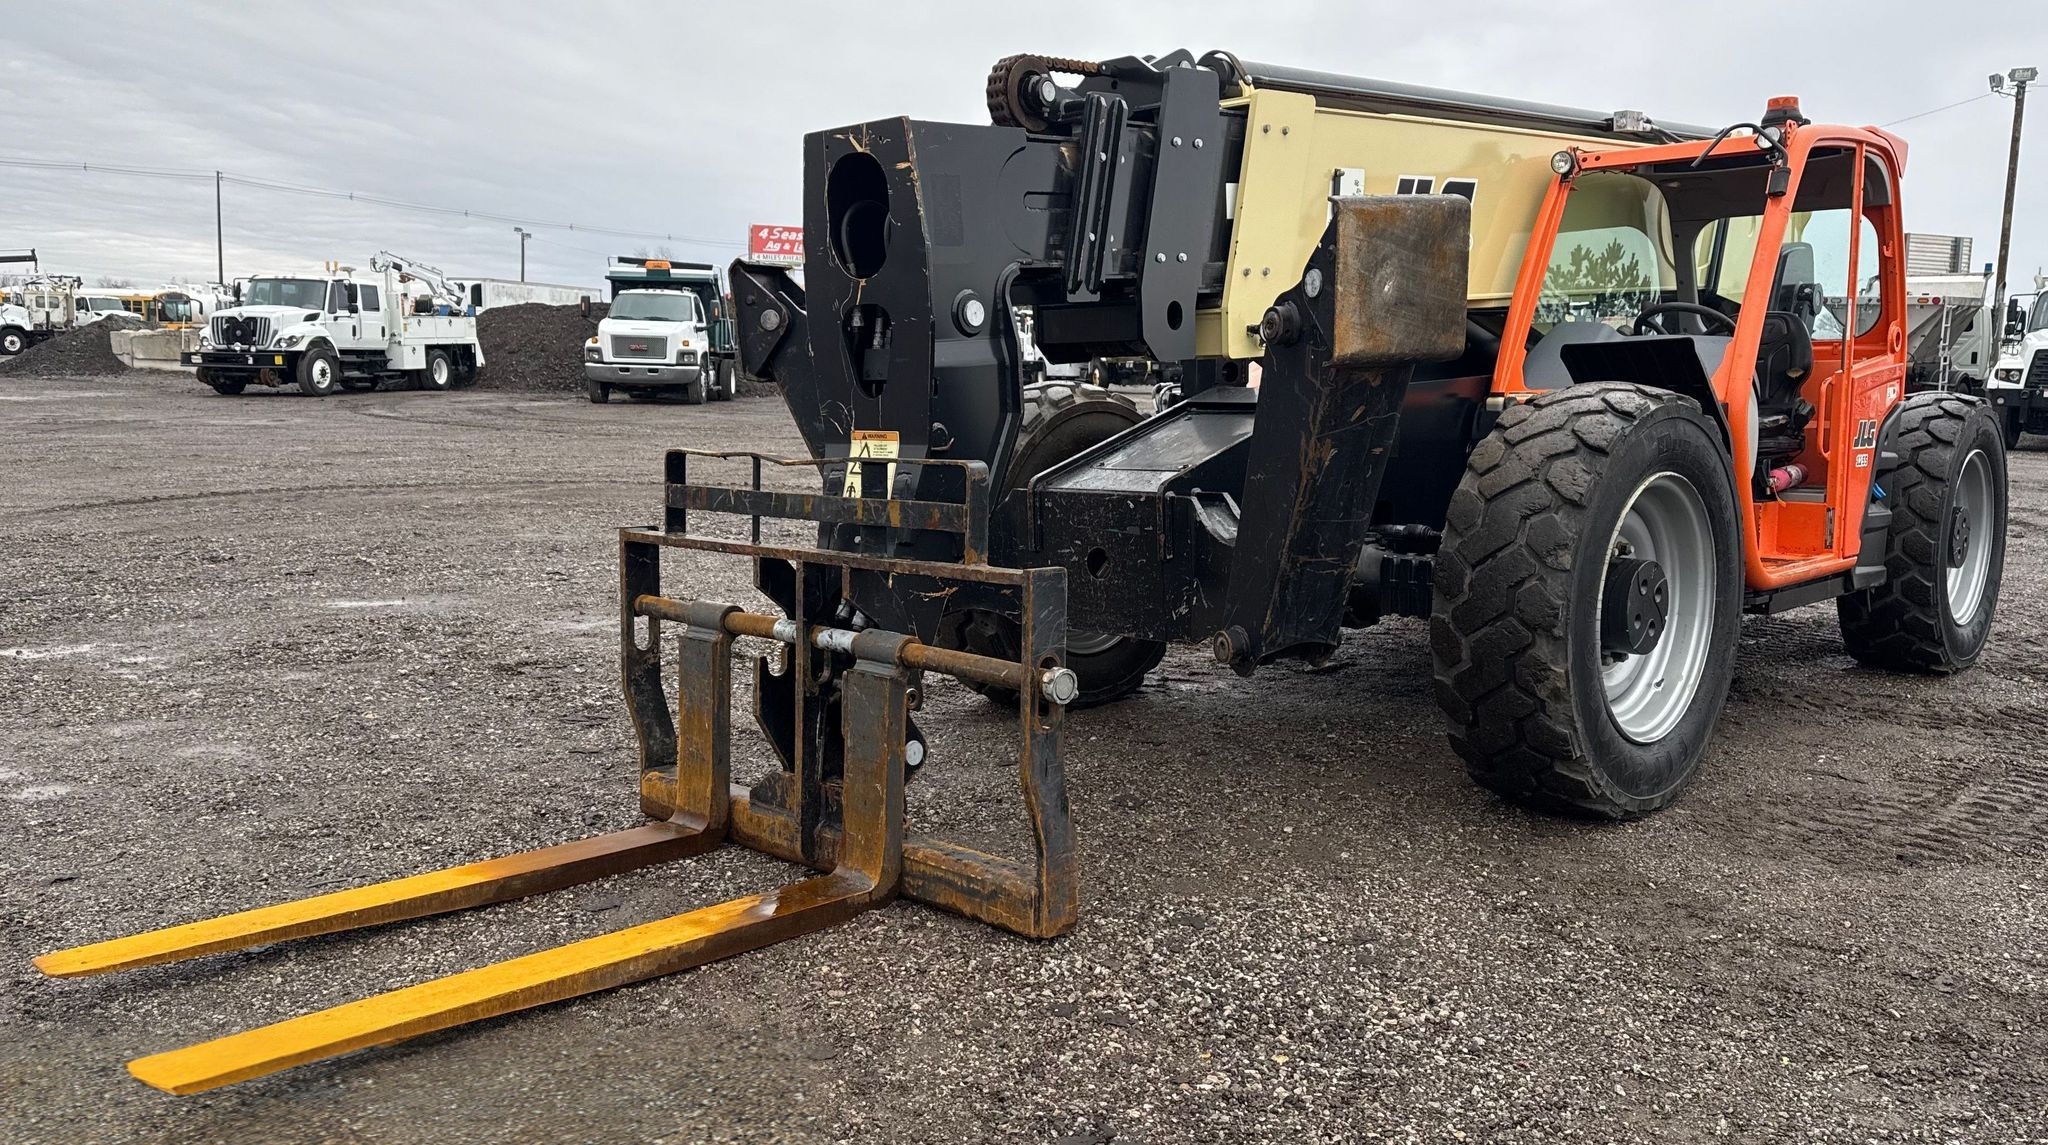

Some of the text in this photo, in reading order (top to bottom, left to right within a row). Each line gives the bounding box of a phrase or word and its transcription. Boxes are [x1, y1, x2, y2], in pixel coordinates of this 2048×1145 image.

[758, 228, 769, 239] 4
[763, 240, 782, 252] Ag
[1853, 420, 1876, 448] JLG
